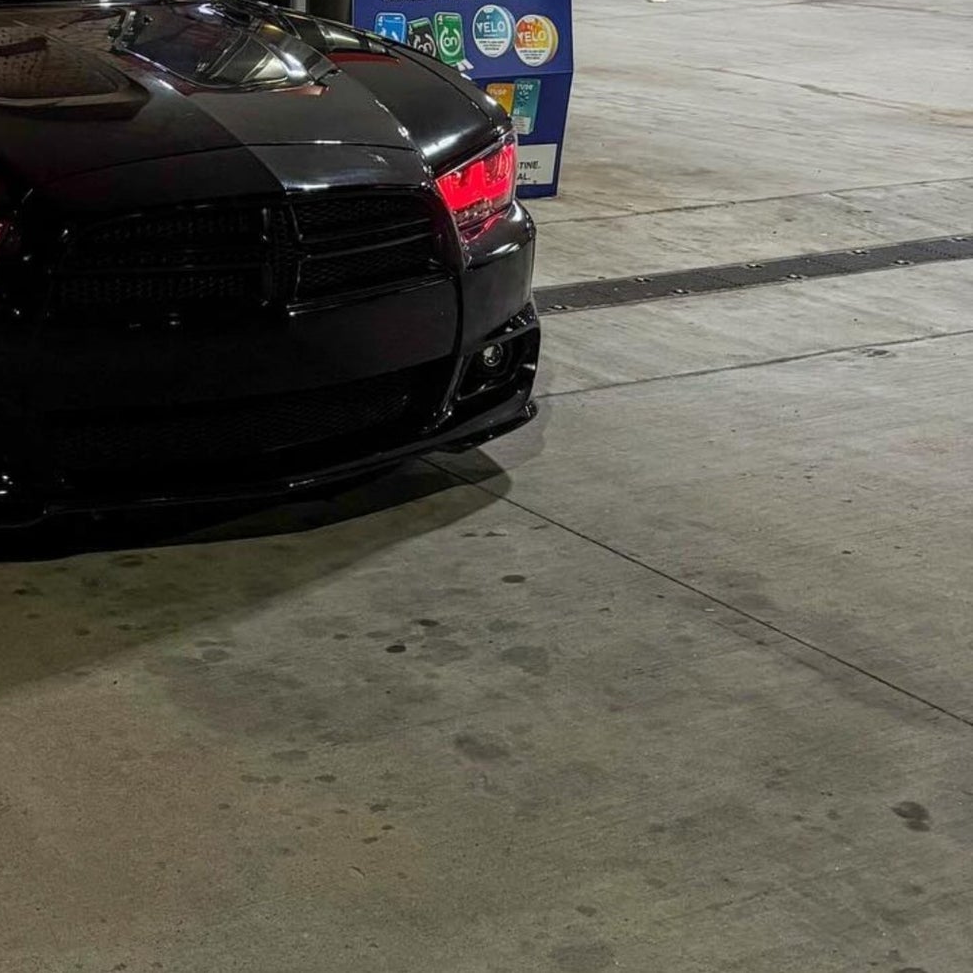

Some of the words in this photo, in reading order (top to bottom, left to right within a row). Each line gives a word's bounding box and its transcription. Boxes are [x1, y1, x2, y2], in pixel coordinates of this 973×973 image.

[476, 21, 506, 33] VELO
[517, 30, 547, 43] VELO
[518, 161, 541, 170] TINE.
